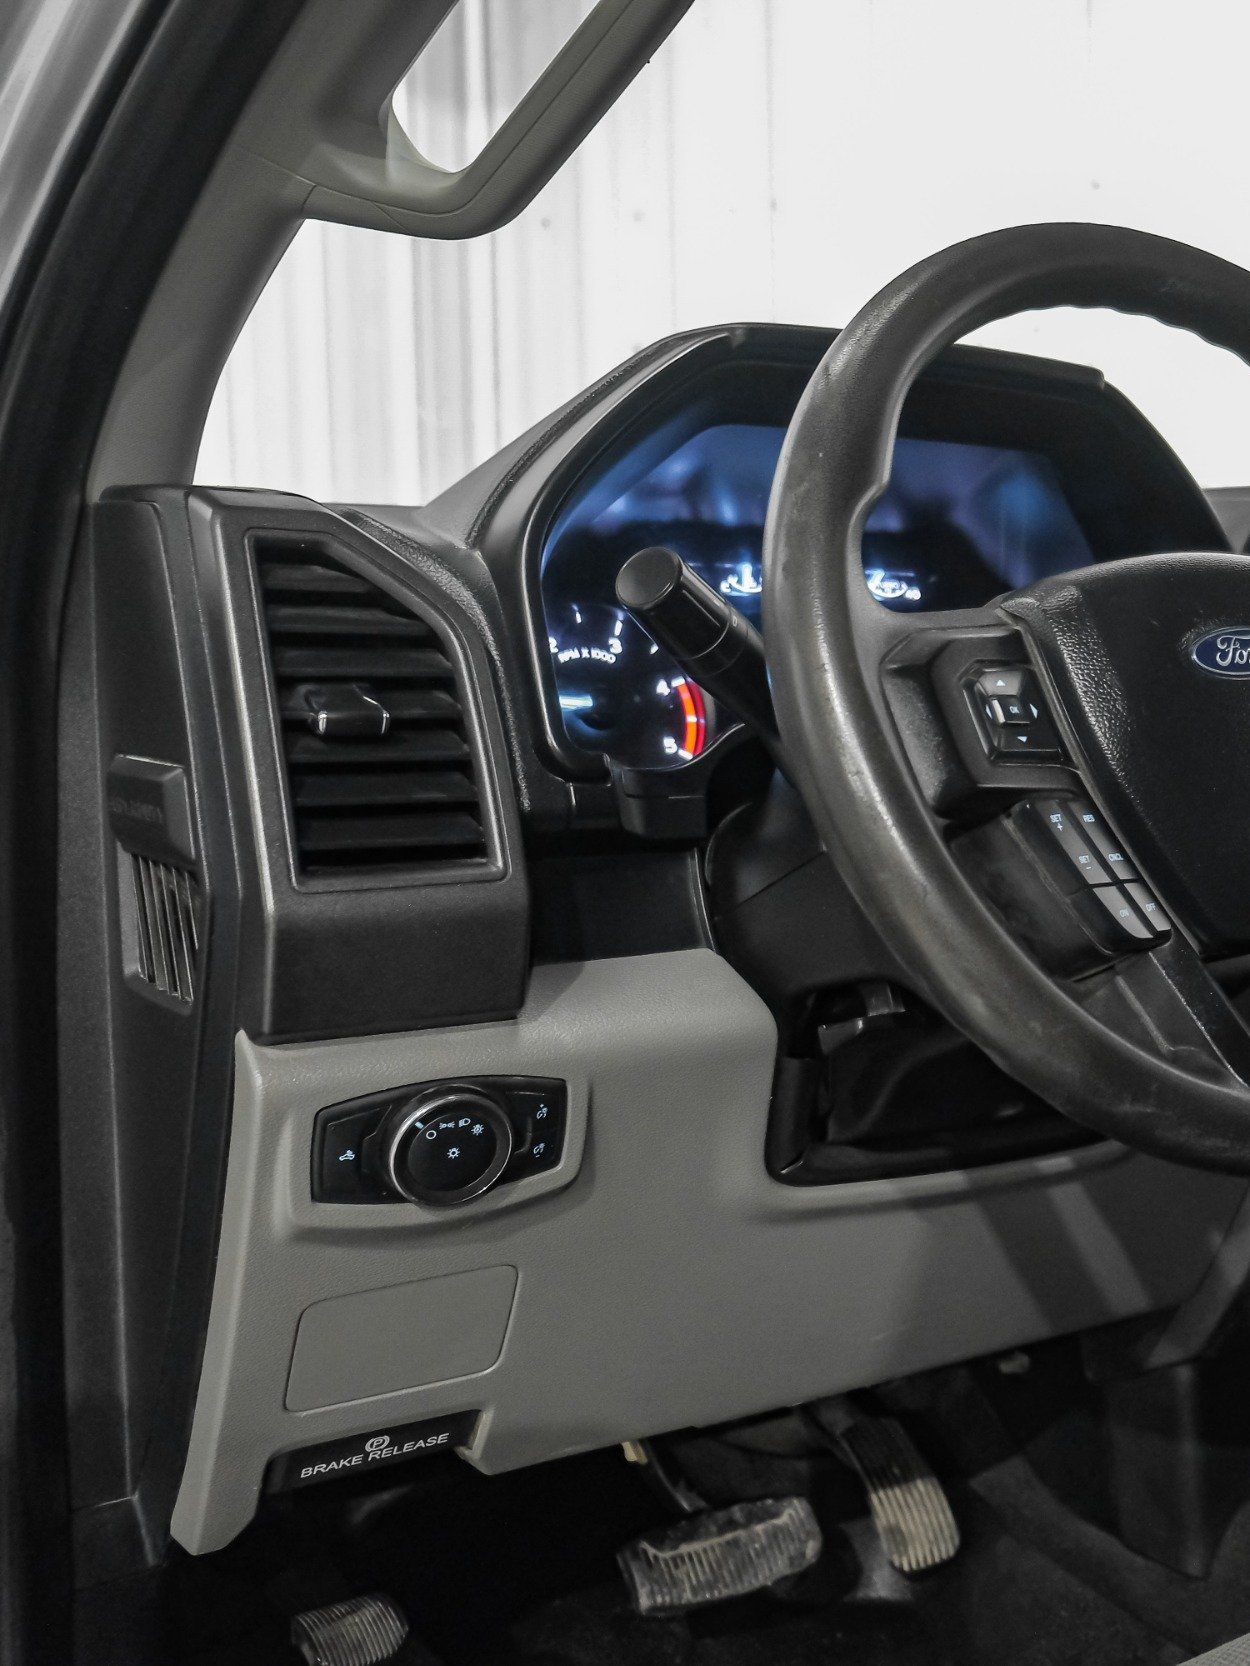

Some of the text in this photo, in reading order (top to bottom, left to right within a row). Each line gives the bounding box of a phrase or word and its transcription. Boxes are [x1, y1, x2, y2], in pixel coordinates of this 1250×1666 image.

[608, 636, 623, 654] 3
[557, 647, 580, 663] RPM
[591, 648, 616, 664] 1000
[656, 679, 670, 696] 4
[663, 736, 678, 754] 5
[300, 1432, 450, 1479] BRAKE RELEASE
